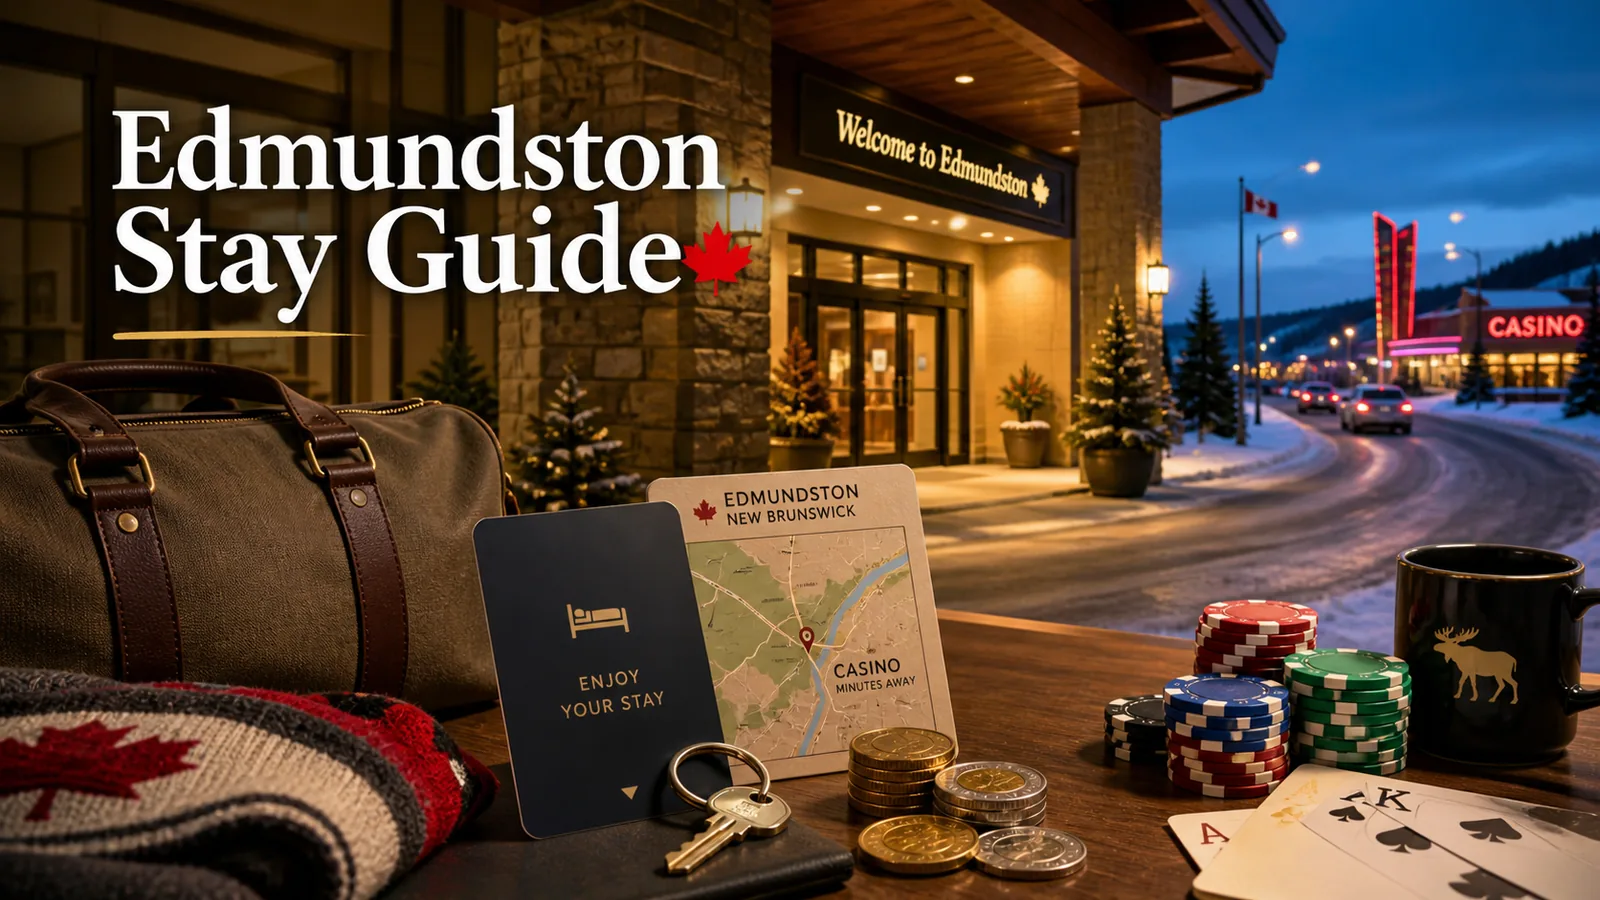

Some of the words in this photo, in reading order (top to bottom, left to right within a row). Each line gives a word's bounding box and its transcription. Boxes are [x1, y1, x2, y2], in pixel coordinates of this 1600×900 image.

[836, 108, 916, 164] Welcome
[919, 141, 936, 170] to
[939, 144, 1029, 199] Edmundston
[1488, 313, 1585, 339] CASINO
[723, 483, 860, 508] EDMUNDSTON
[726, 510, 762, 526] NEW
[767, 504, 856, 523] BRUNSWICK
[579, 668, 640, 691] ENJOY
[833, 657, 901, 680] CASINO
[835, 681, 883, 695] MINUTES
[885, 675, 916, 689] AWAY
[560, 698, 614, 720] YOUR
[620, 690, 665, 712] STAY
[1374, 786, 1412, 812] K
[1200, 822, 1229, 845] A
